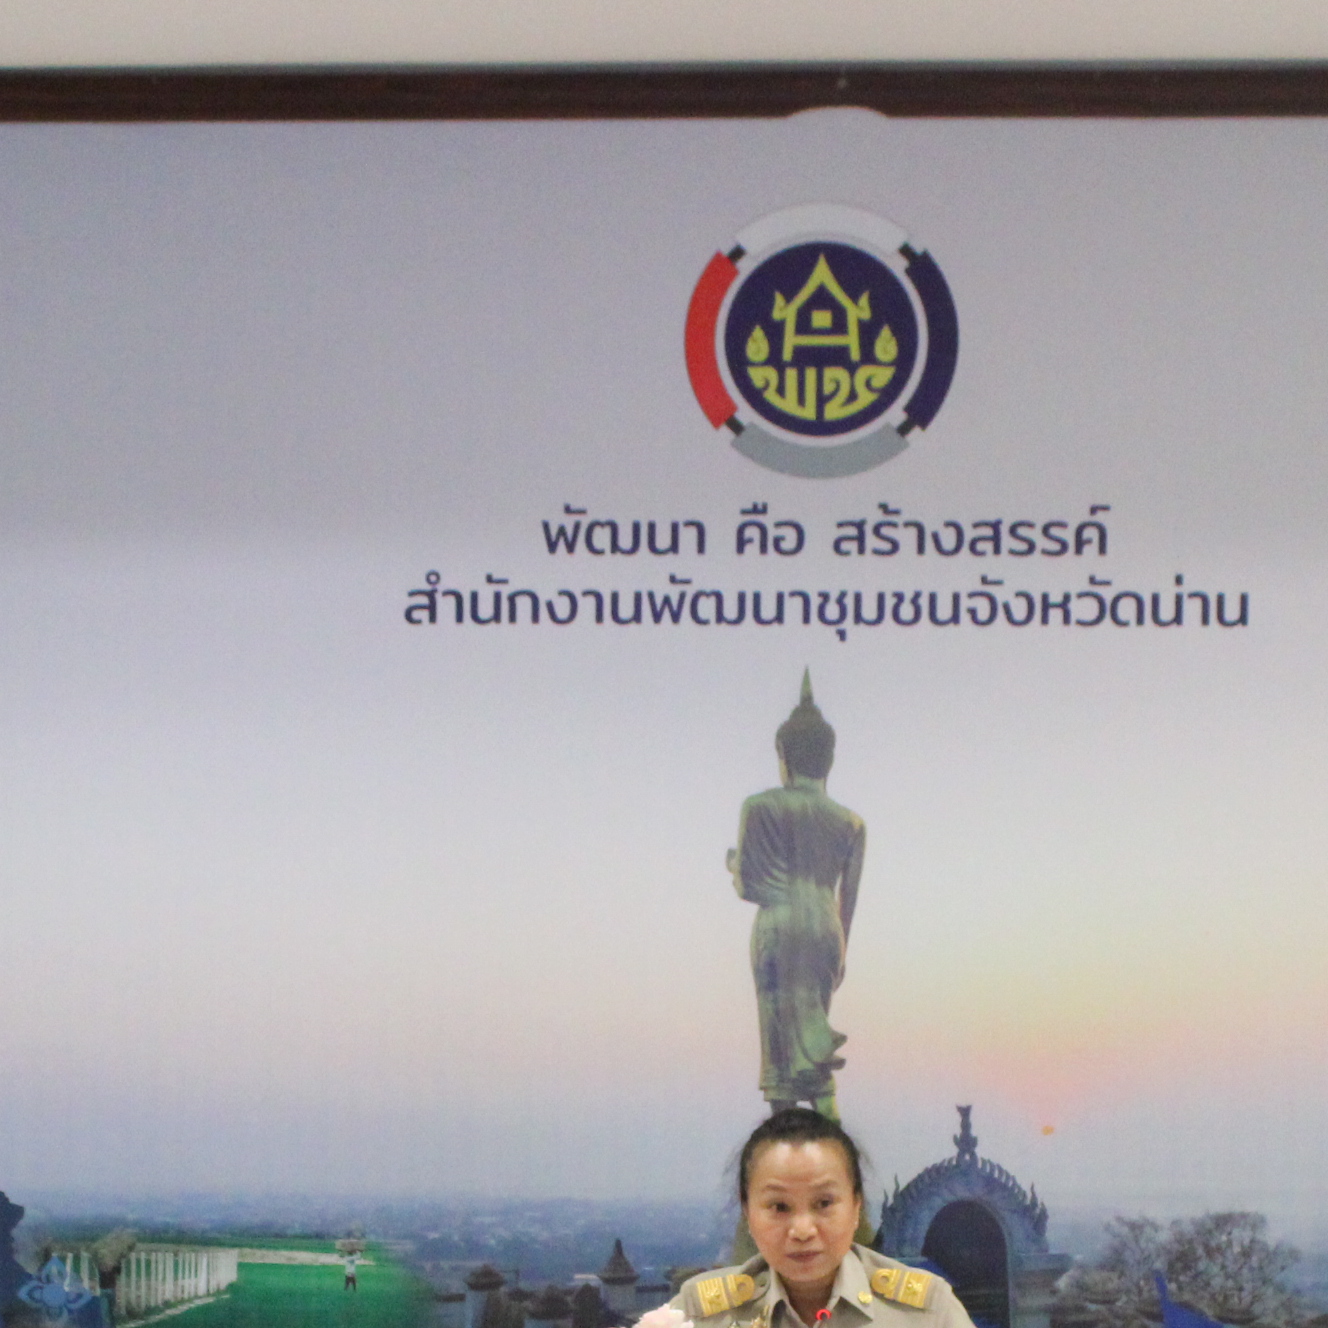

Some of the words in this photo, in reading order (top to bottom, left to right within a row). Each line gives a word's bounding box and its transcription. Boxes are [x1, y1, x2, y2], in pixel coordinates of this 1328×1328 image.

[541, 503, 707, 557] พัฒนา
[734, 501, 806, 558] คือ
[832, 502, 1111, 558] สร้างสรรค์
[403, 570, 1250, 642] สำนักงานพัฒนาชุมชนจังหวัดน่าน
